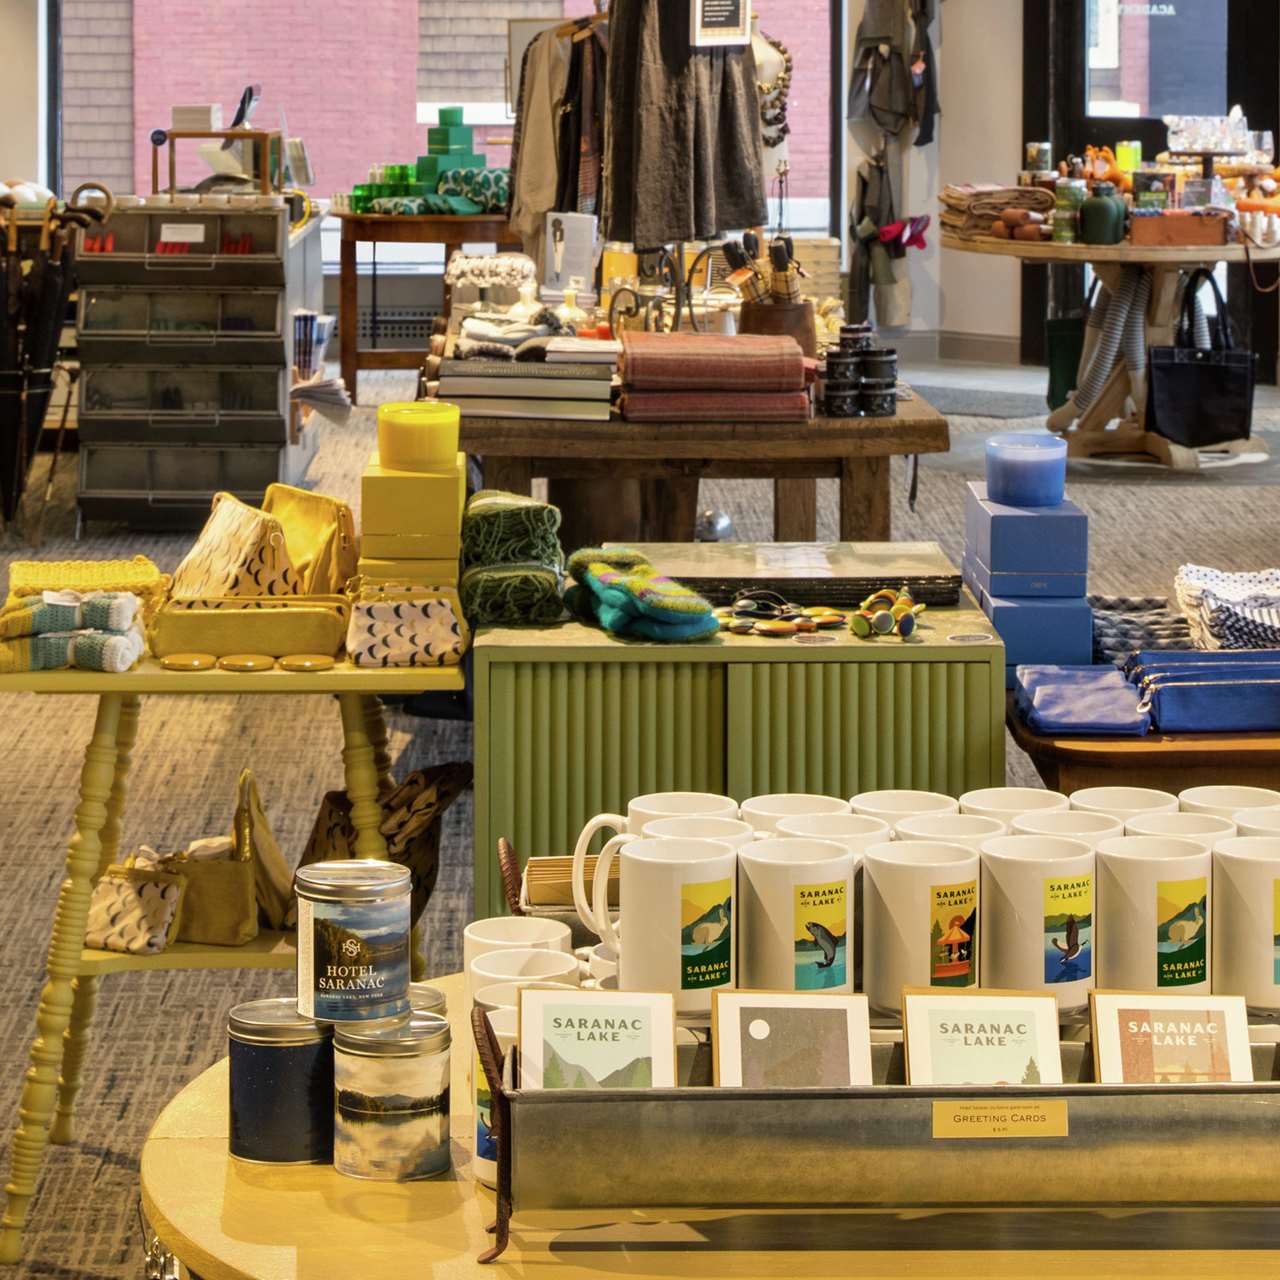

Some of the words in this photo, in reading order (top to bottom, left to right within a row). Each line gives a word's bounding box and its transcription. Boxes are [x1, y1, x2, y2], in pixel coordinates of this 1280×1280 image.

[1049, 879, 1090, 892] SARANAC
[799, 886, 844, 898] SARANAC
[936, 886, 976, 899] SARANAC
[1062, 892, 1083, 900] LAKE
[812, 898, 835, 907] LAKE
[948, 898, 969, 907] LAKE
[327, 965, 377, 977] HOTEL
[687, 960, 729, 974] SARANAC
[1162, 959, 1205, 971] SARANAC
[698, 973, 721, 982] LAKE
[1175, 970, 1197, 979] LAKE
[319, 976, 385, 990] SARANAC
[553, 1017, 642, 1030] SARANAC
[939, 1022, 1027, 1035] SARANAC
[1128, 1021, 1218, 1034] SARANAC
[577, 1031, 620, 1041] LAKE
[964, 1036, 1007, 1047] LAKE
[1153, 1035, 1197, 1046] LAKE
